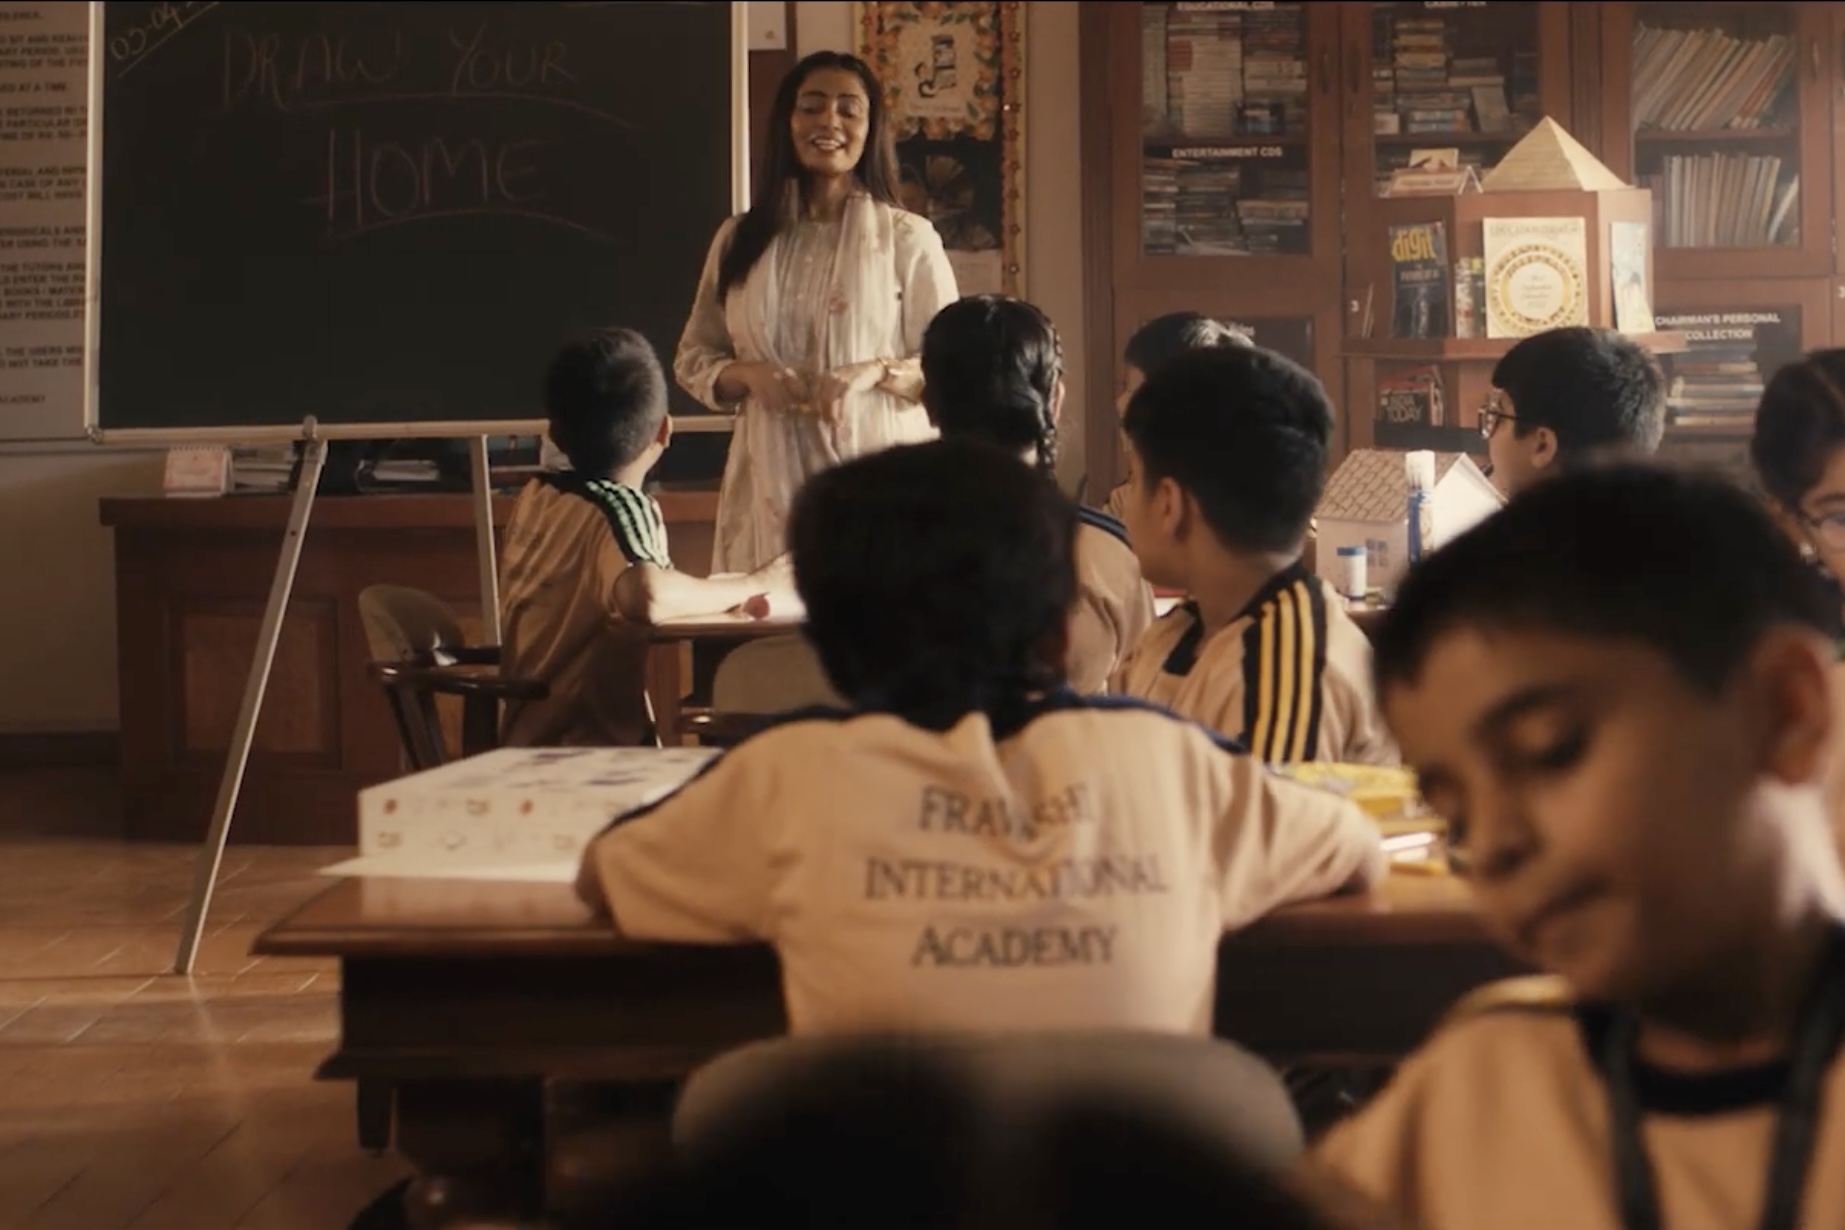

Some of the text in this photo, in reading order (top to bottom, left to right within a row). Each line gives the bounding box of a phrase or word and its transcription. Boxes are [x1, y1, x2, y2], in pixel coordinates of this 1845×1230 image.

[223, 20, 578, 111] DRAW YOUR
[1171, 146, 1283, 159] ENTERTAINMENT CDS
[298, 127, 550, 231] HOME
[1391, 225, 1437, 263] digit
[1655, 312, 1781, 326] CHAIRMAN'S PERSONAL
[1685, 329, 1753, 341] COLLECTION
[910, 922, 1118, 969] ACADEMY
